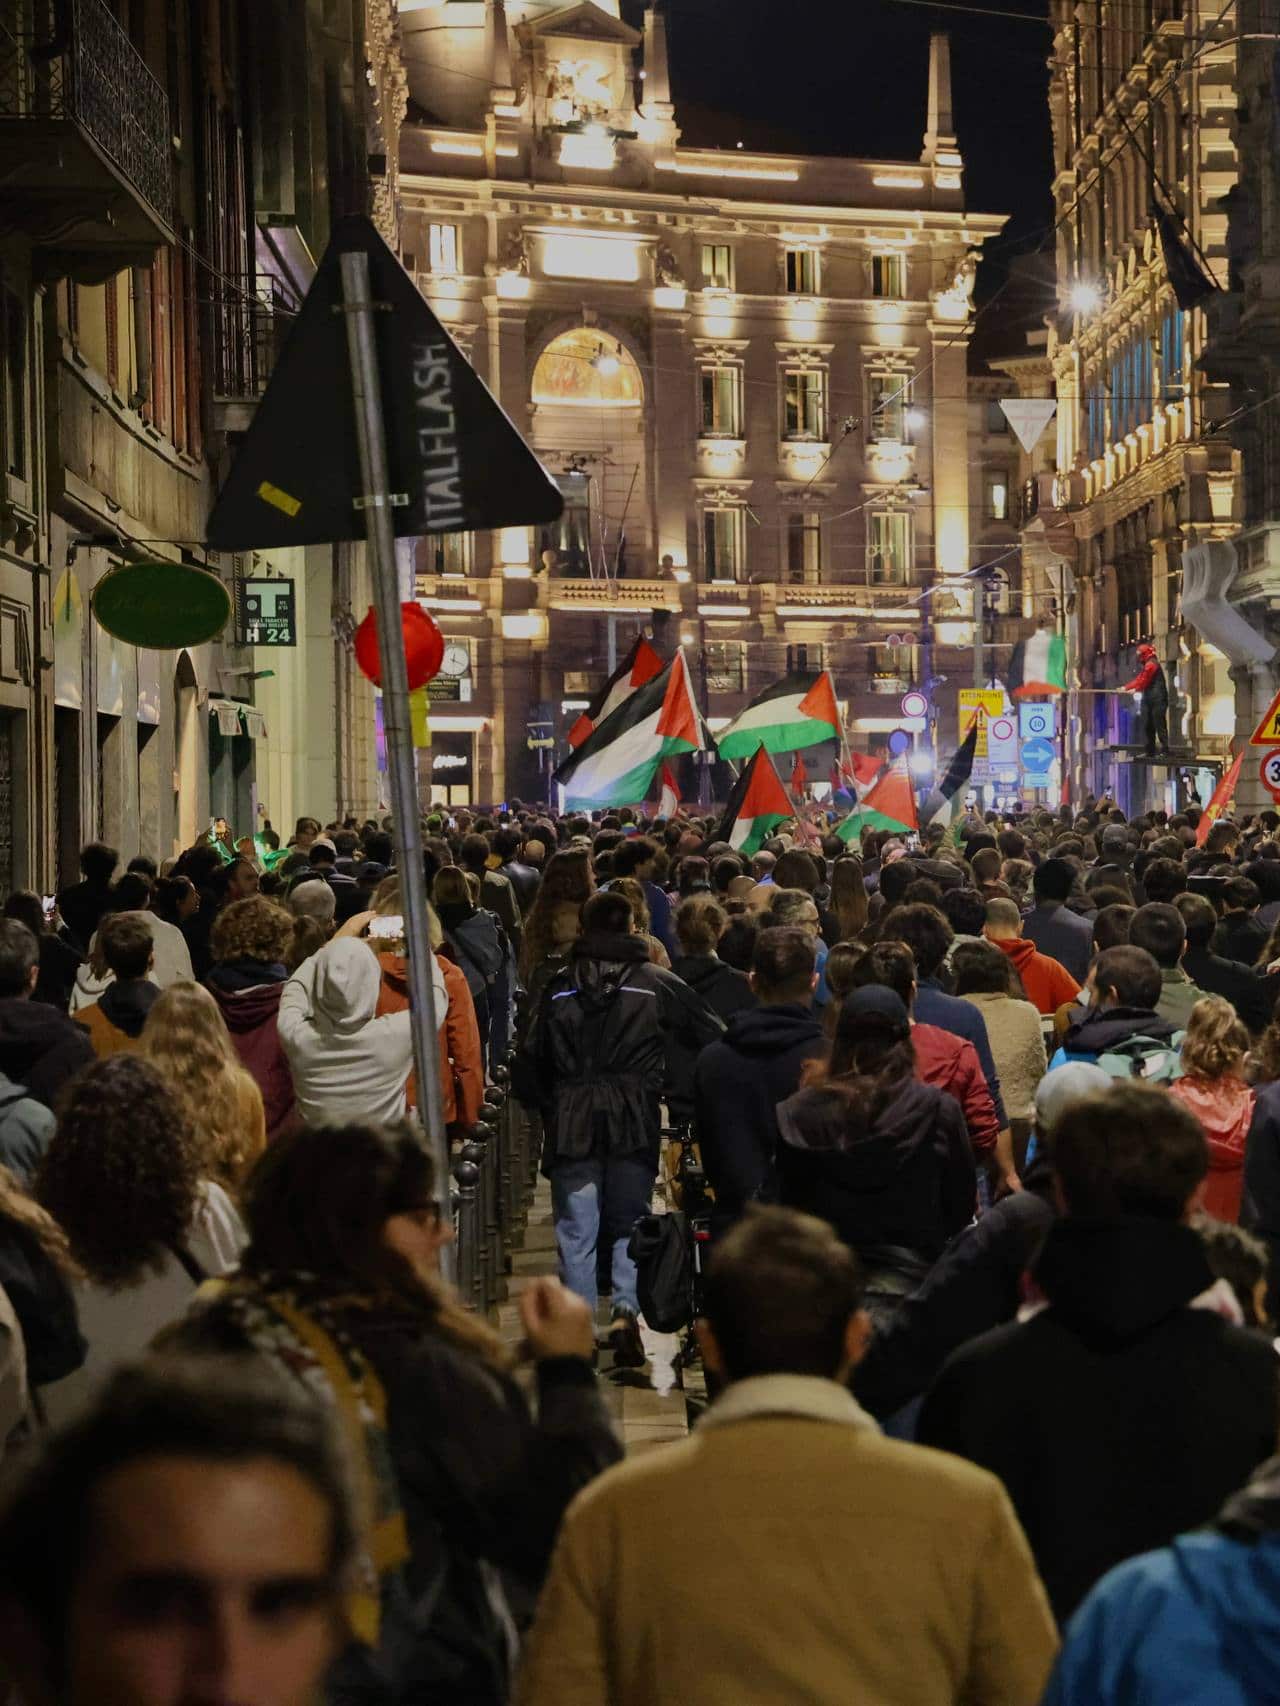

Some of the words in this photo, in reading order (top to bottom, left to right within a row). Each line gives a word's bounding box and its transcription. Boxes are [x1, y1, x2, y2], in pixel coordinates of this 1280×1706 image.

[413, 343, 464, 529] ITALFLASH
[246, 583, 290, 617] T
[246, 628, 259, 643] H
[267, 628, 290, 643] 24
